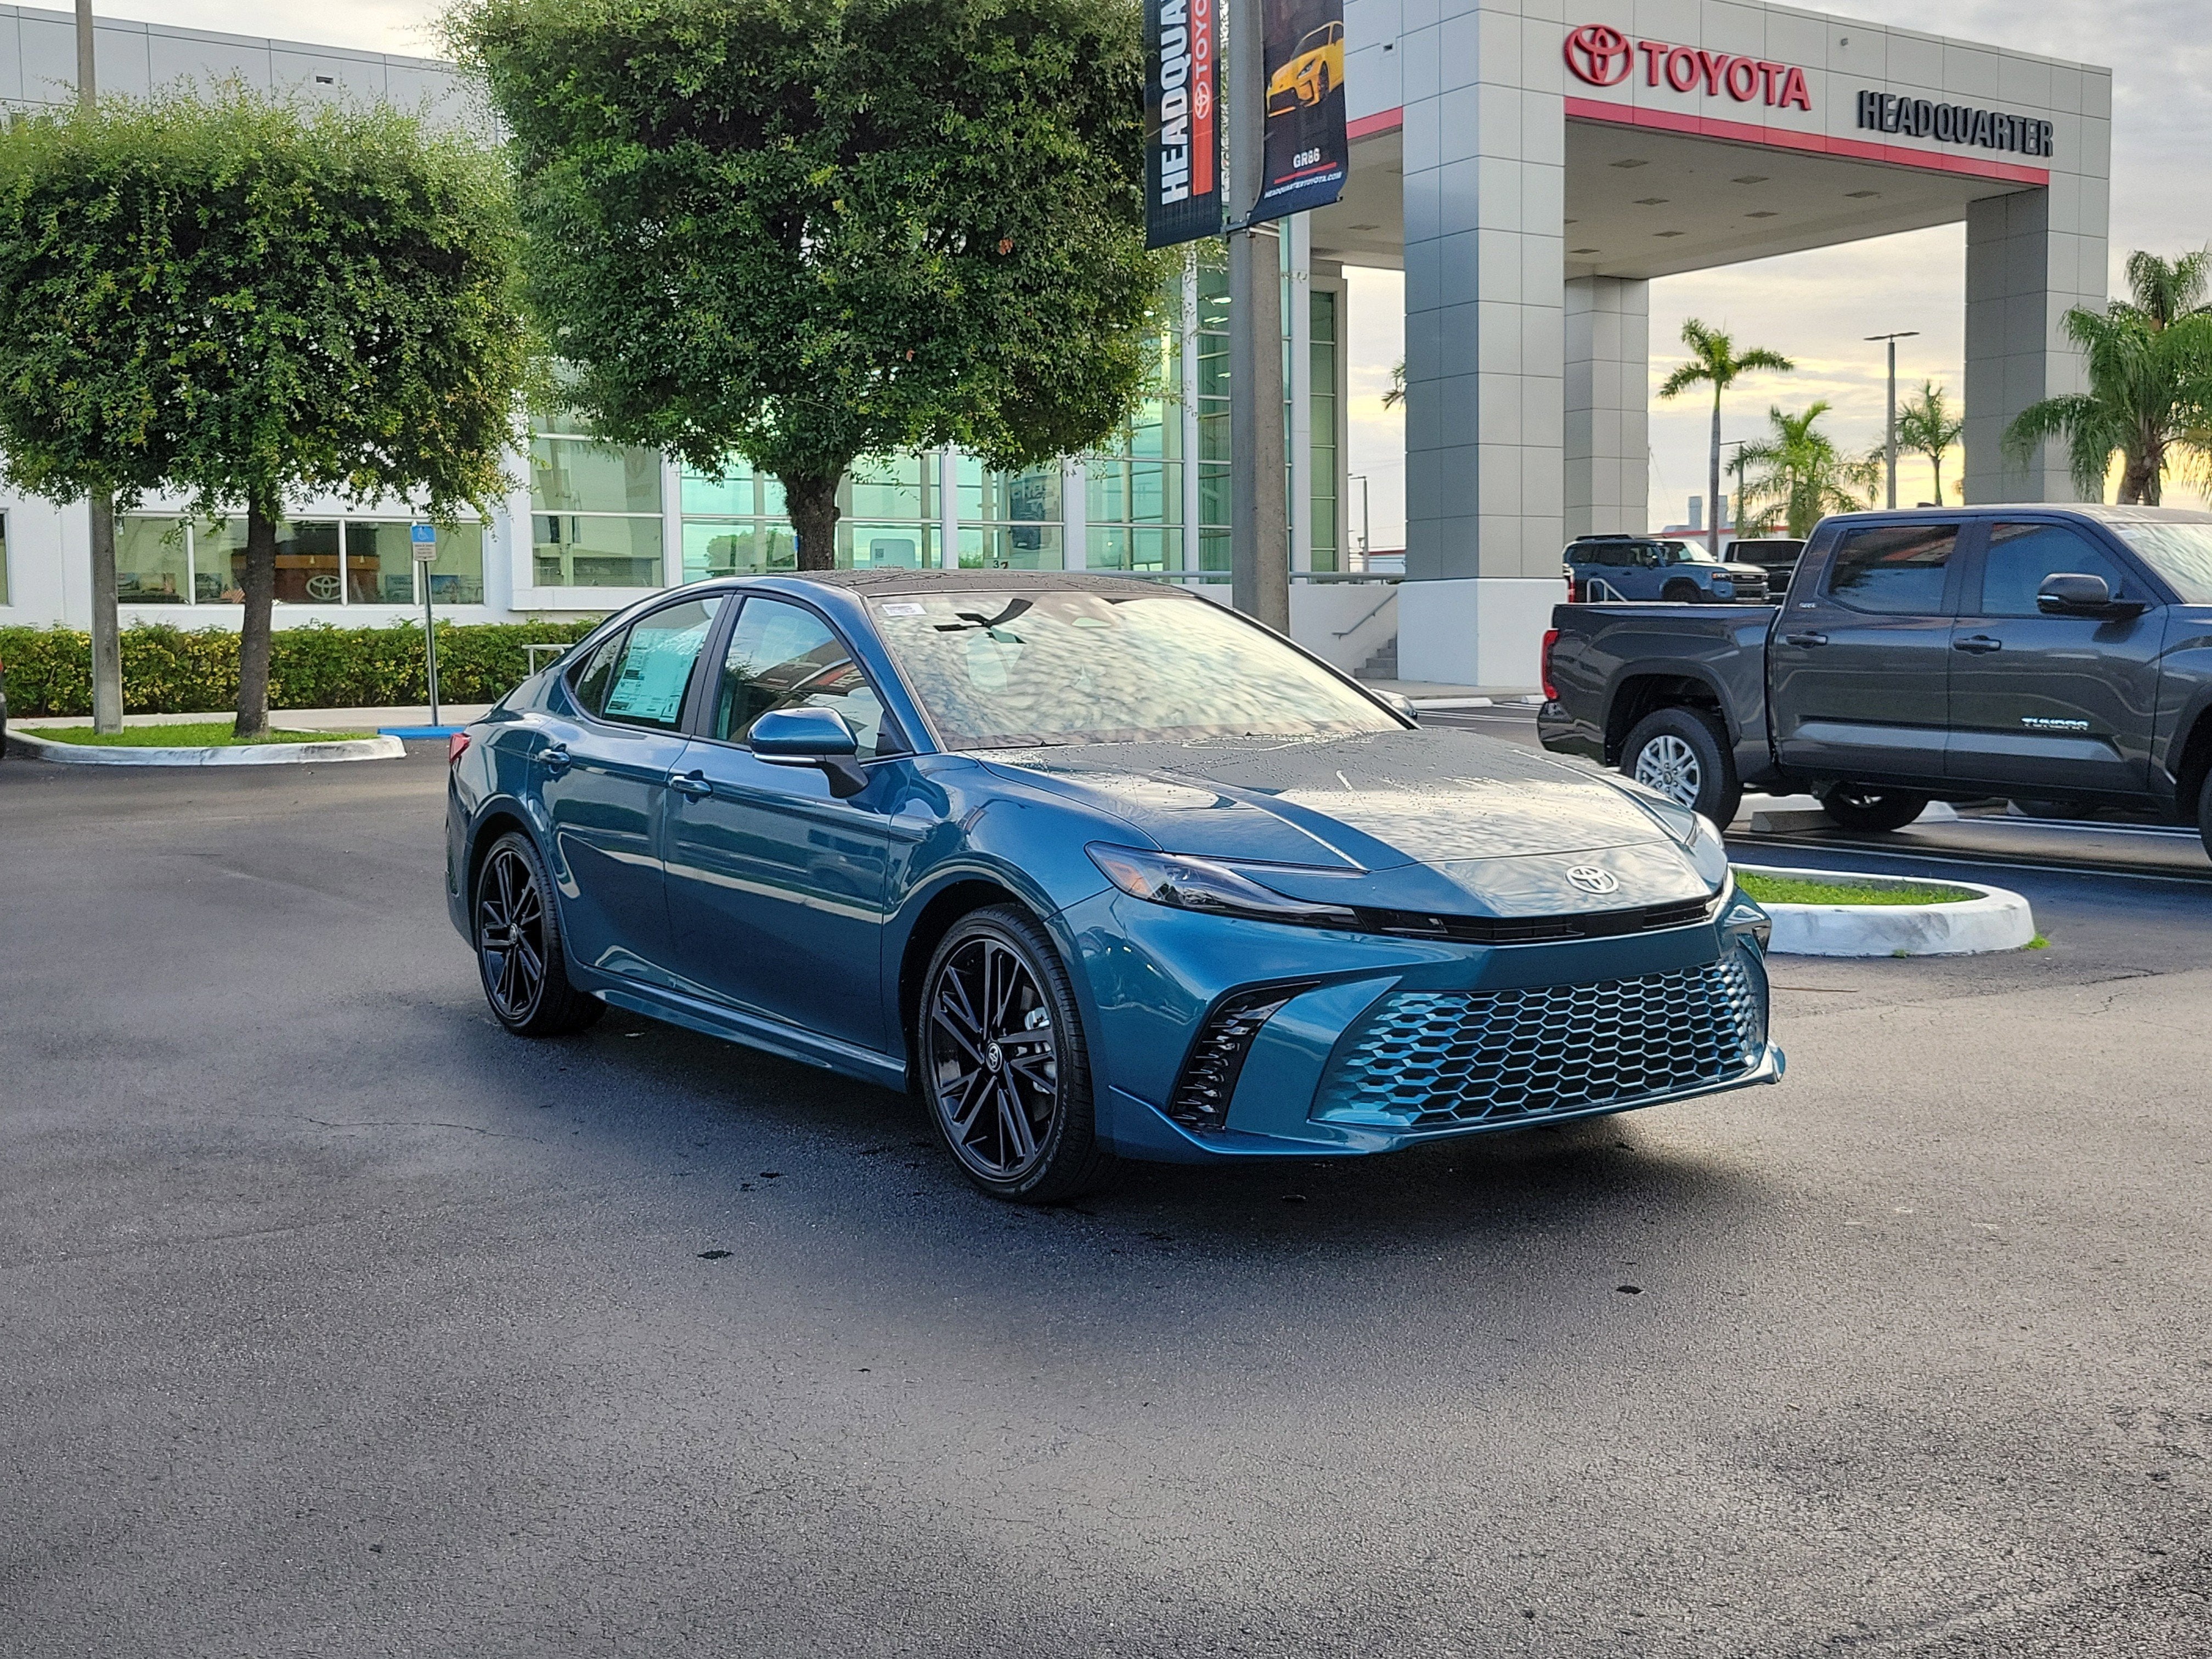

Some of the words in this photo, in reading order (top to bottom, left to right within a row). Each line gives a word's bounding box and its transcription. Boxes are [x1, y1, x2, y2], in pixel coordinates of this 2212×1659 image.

[1638, 41, 1812, 110] TOYOTA
[1858, 90, 2054, 157] HEADQUARTER
[1293, 147, 1321, 168] GR86
